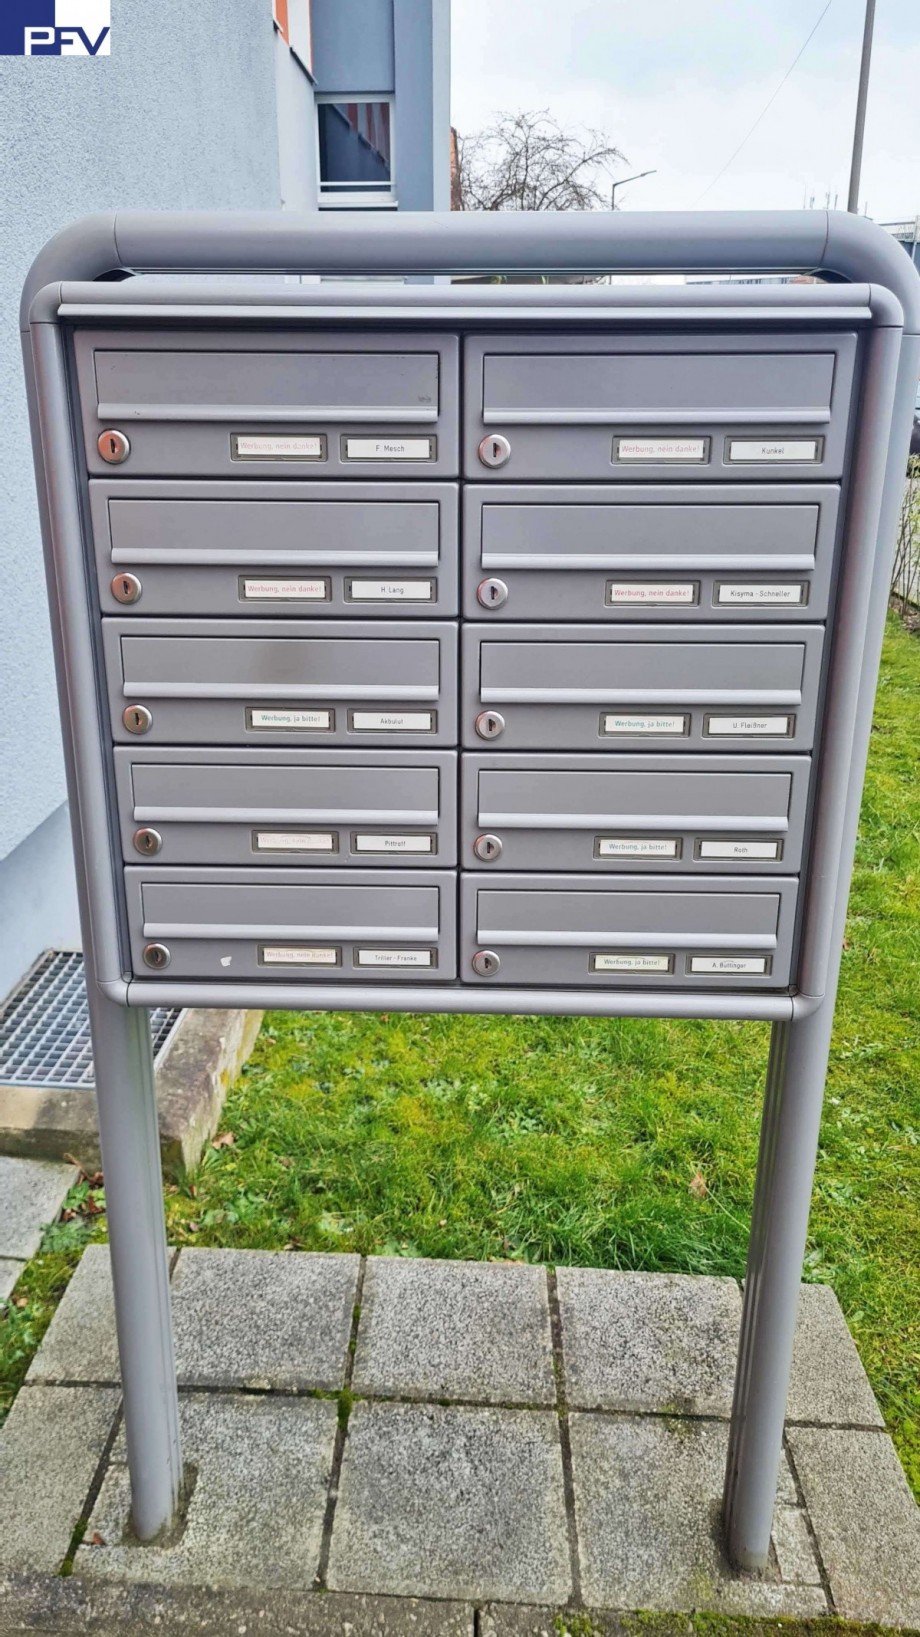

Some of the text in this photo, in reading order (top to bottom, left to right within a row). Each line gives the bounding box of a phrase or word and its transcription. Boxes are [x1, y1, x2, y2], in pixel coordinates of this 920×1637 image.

[294, 442, 318, 450] danke!
[622, 445, 654, 454] Werbung,
[248, 585, 280, 594] Werbung,
[614, 590, 646, 598] Werbung,
[614, 720, 646, 728] Werbung,
